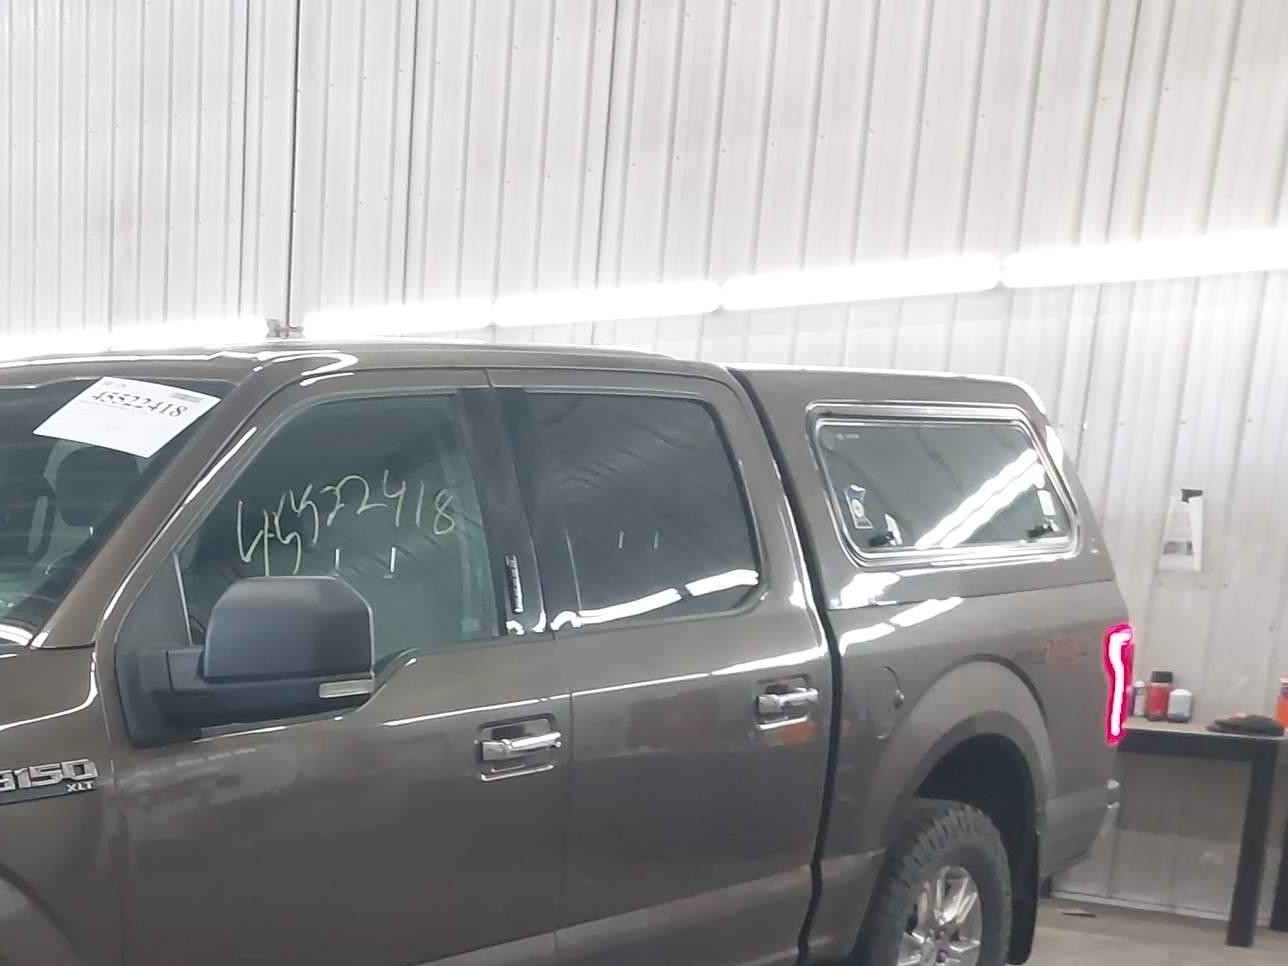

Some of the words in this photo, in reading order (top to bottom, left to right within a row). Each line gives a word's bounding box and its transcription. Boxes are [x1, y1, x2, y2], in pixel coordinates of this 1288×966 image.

[92, 390, 188, 418] 45522418
[236, 469, 455, 577] 45522418
[66, 780, 94, 793] XLT
